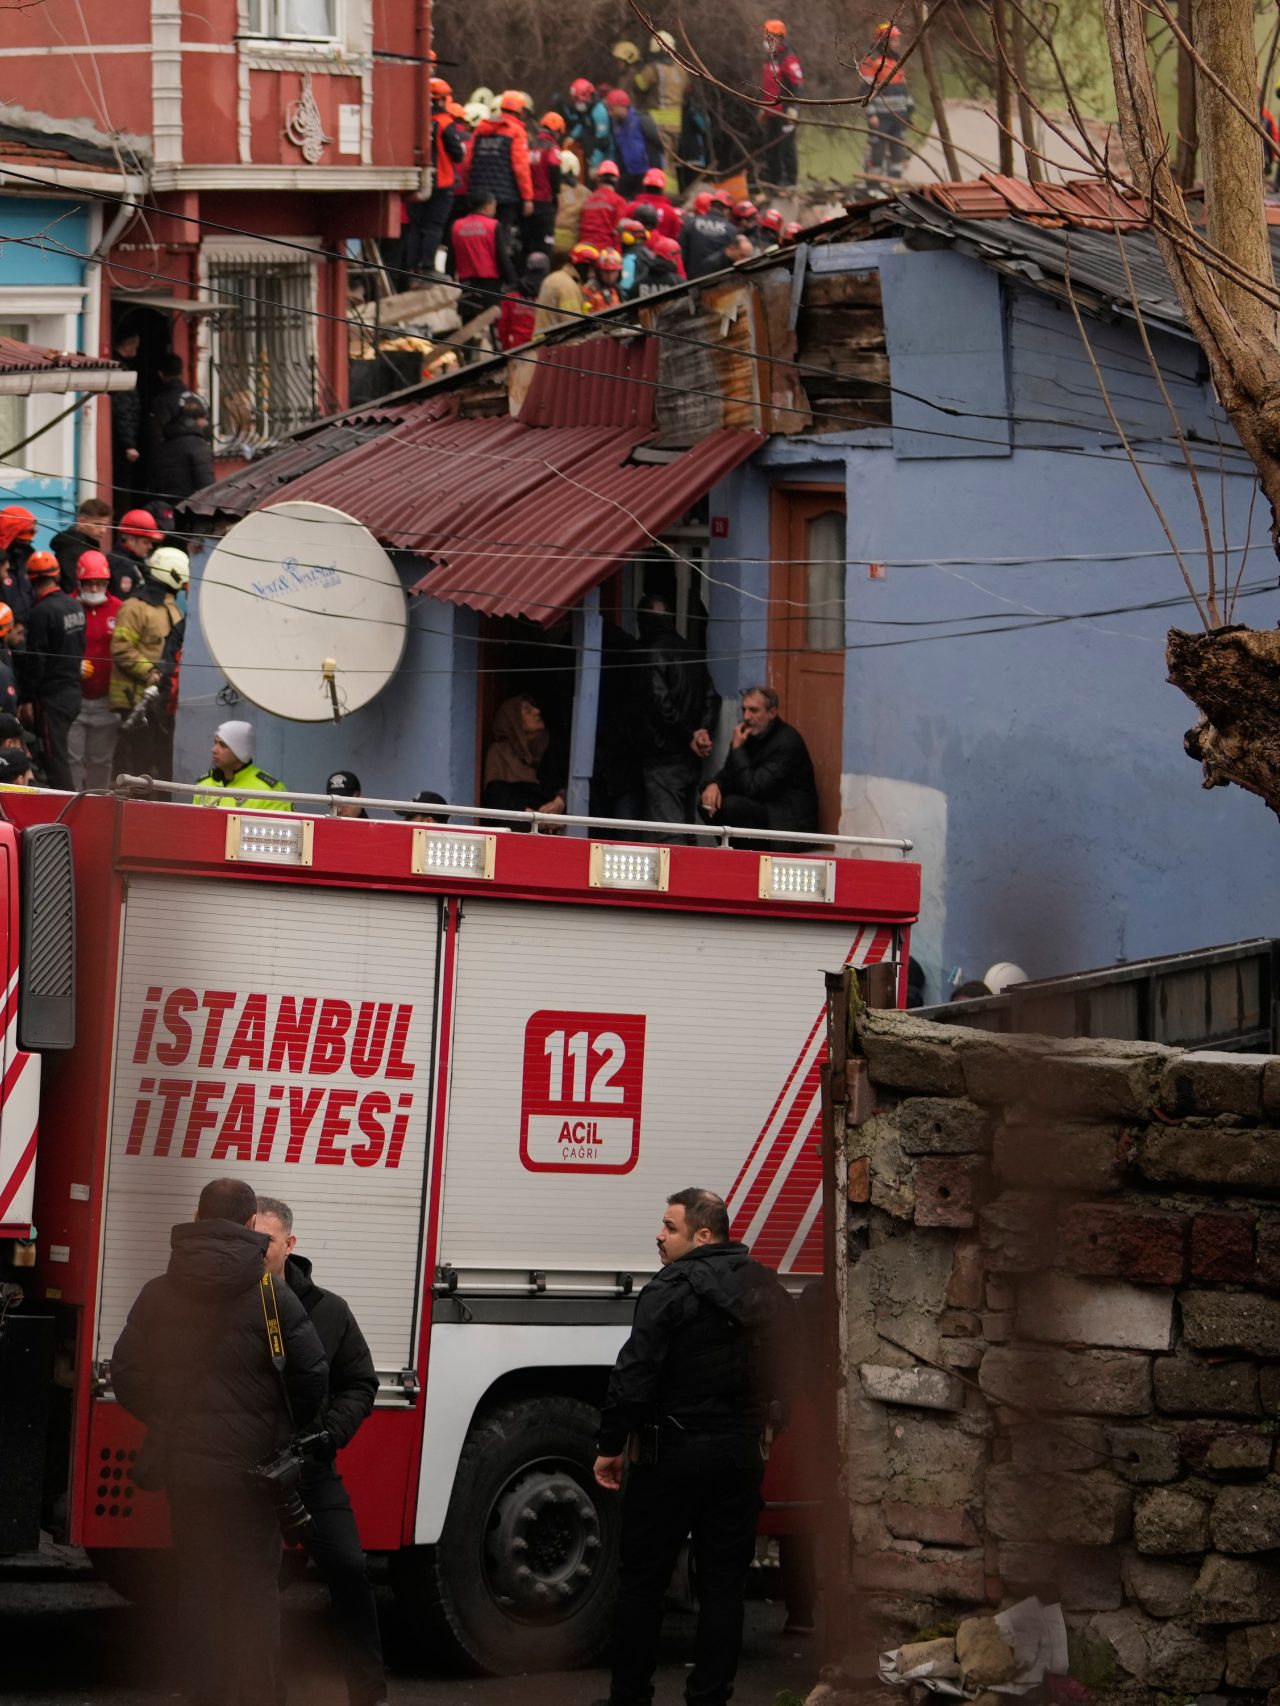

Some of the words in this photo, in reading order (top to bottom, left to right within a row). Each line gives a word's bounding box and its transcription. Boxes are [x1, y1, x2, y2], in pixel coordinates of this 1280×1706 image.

[132, 986, 416, 1081] İSTANBUL
[544, 1030, 626, 1104] 112
[125, 1077, 414, 1169] İTFAİYESİ
[558, 1121, 603, 1145] ACİL
[562, 1146, 598, 1160] ÇAĞRI
